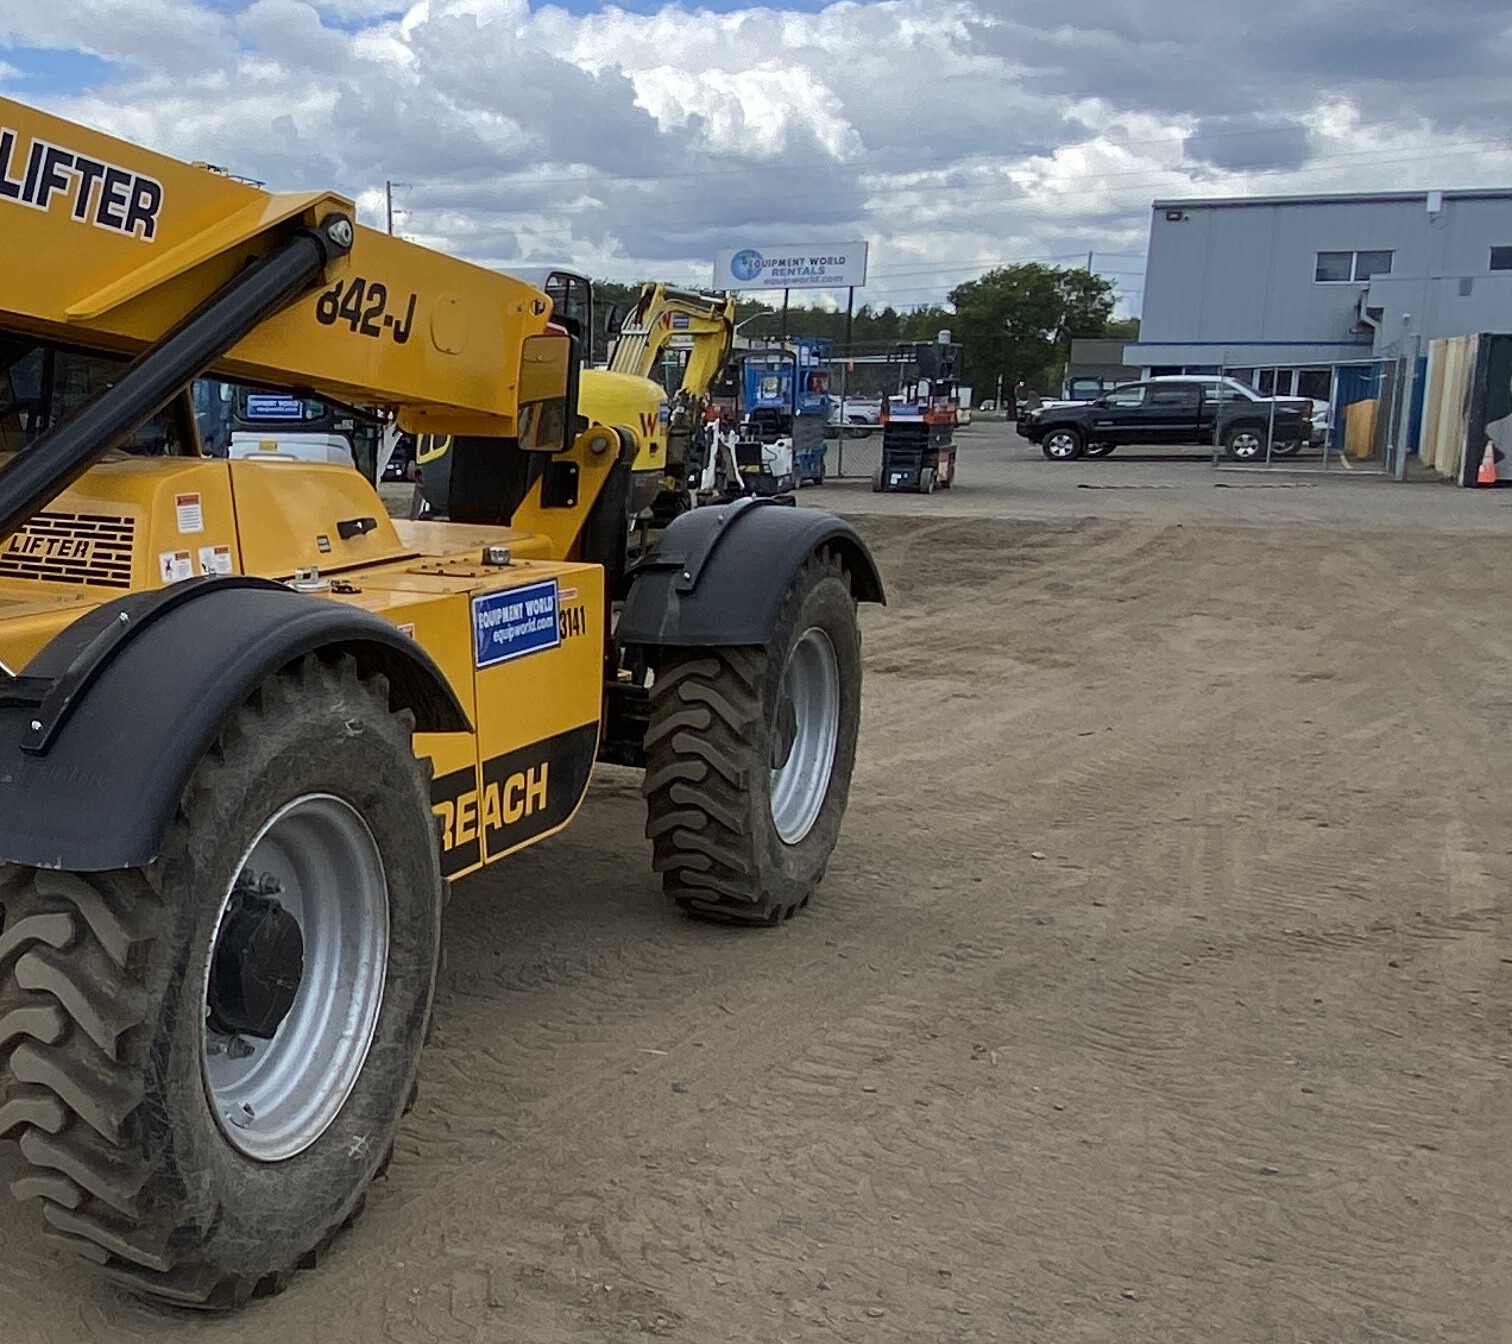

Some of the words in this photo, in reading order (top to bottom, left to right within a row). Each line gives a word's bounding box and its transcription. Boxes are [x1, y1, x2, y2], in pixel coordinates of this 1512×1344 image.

[749, 257, 805, 268] EQUIPMENT
[810, 256, 846, 265] WORLD
[771, 266, 826, 277] RENTALS
[315, 276, 417, 344] 842-J
[8, 534, 90, 558] LIFTER
[477, 602, 524, 629] EQUIPMENT
[524, 596, 554, 617] WORLD
[559, 605, 586, 639] 3141
[492, 616, 554, 644] equipworld.com
[431, 761, 549, 851] REACH
